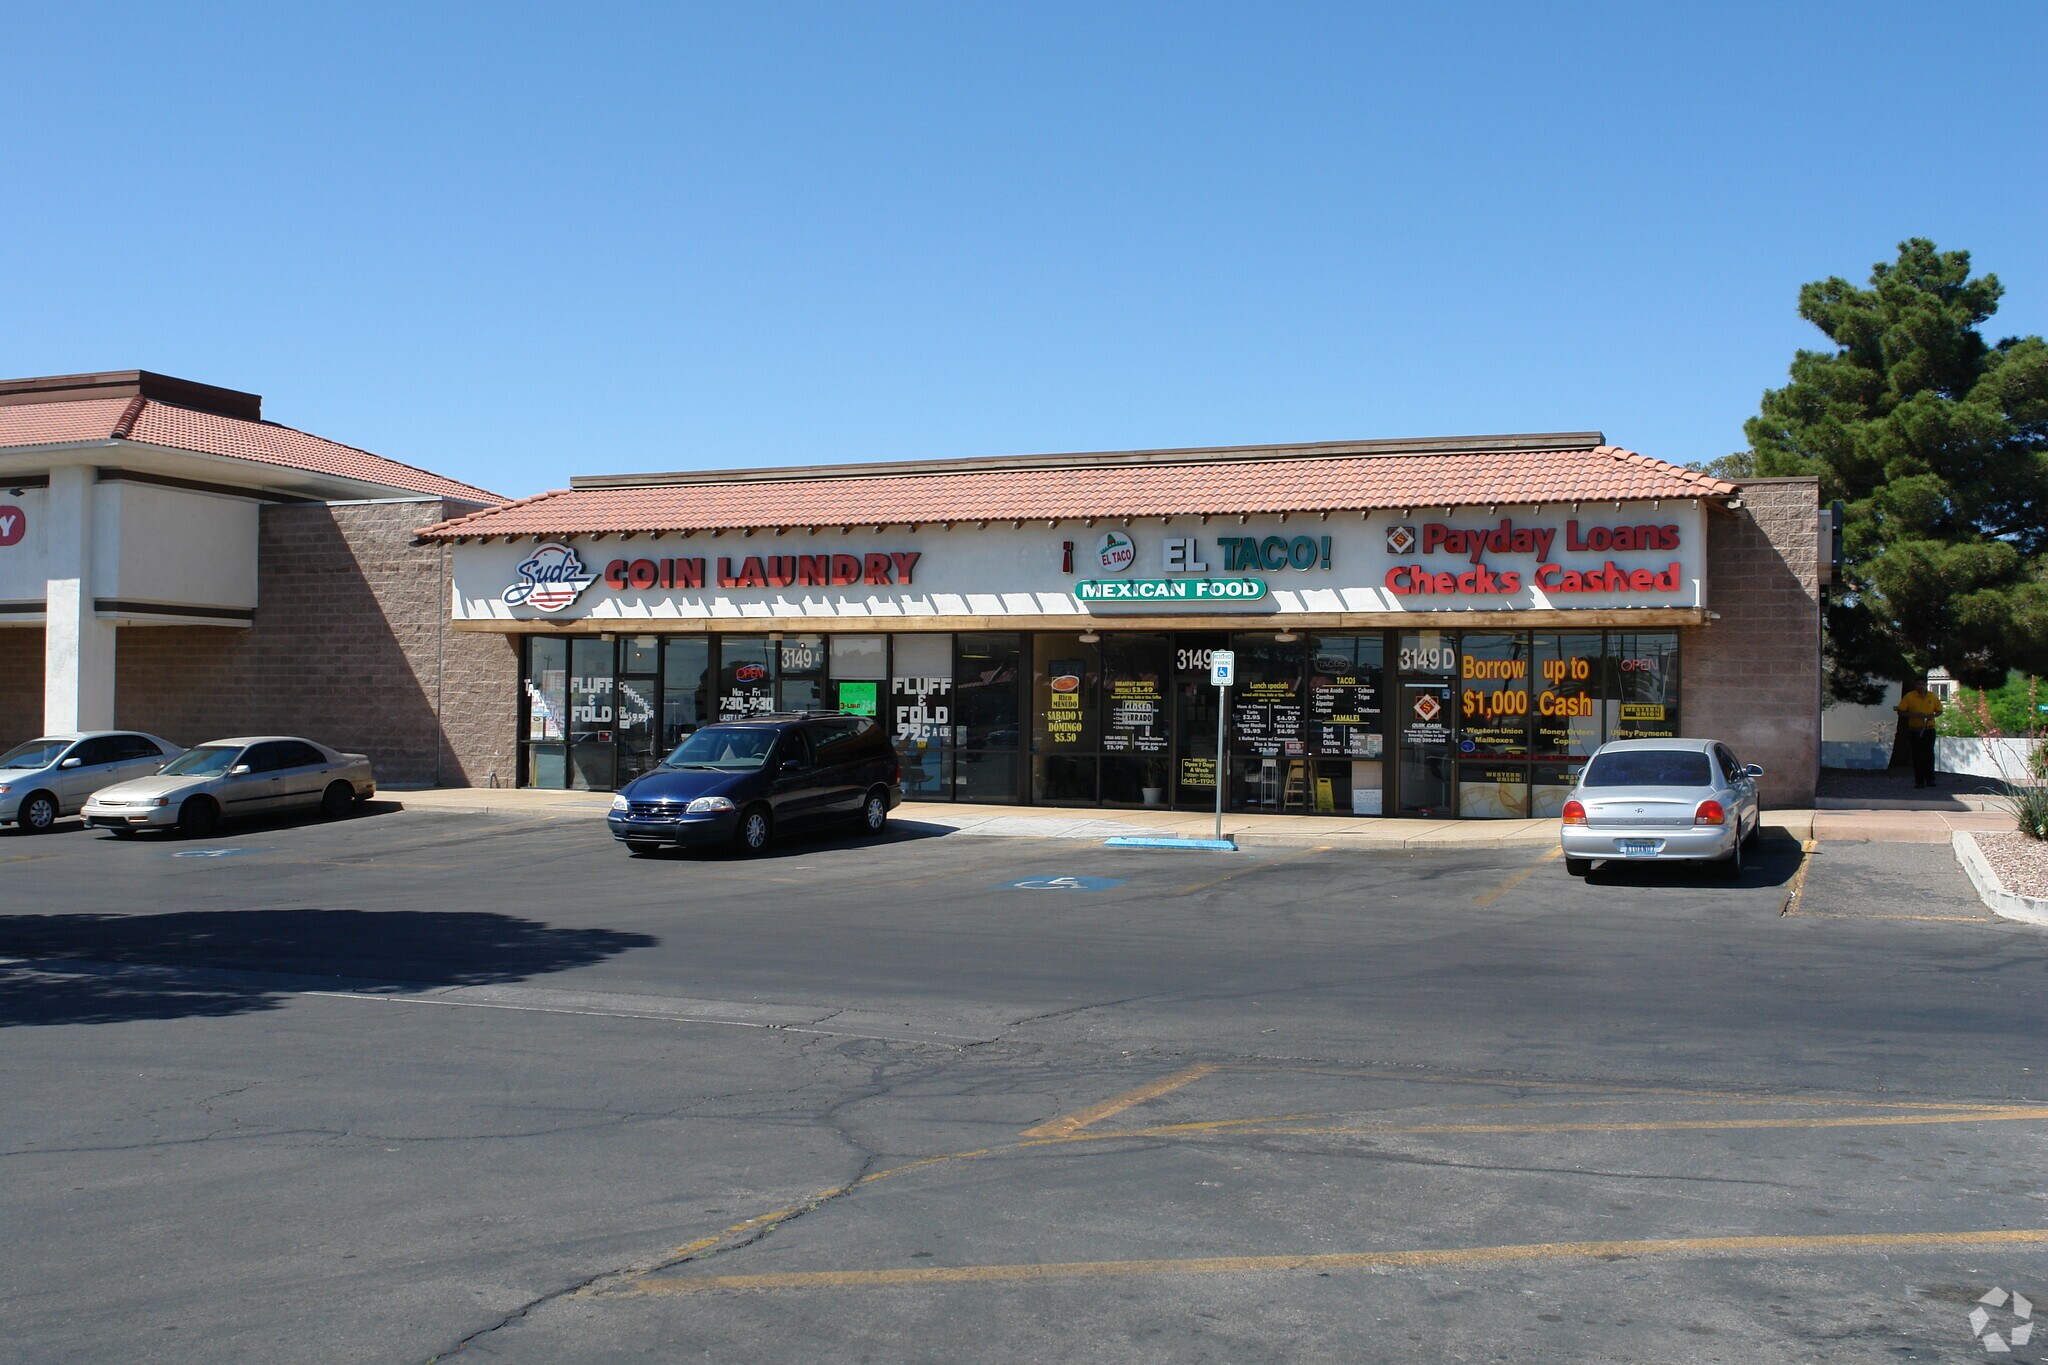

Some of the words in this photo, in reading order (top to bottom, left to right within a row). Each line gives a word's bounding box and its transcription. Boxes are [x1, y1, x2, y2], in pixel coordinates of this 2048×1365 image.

[1423, 519, 1556, 563] Payday
[1566, 520, 1681, 551] Loans
[1102, 554, 1111, 566] EL
[1112, 549, 1132, 563] TACO
[1163, 538, 1207, 572] EL
[1217, 535, 1332, 571] TACO!
[504, 552, 591, 603] Sudz
[604, 558, 706, 590] COIN
[716, 551, 922, 588] LAUNDRY
[1385, 564, 1521, 595] Checks
[1535, 561, 1681, 593] Cashed
[1082, 584, 1186, 598] MEXICAN
[1196, 582, 1259, 597] FOOD
[782, 649, 812, 668] 3149
[815, 654, 820, 662] A
[1177, 649, 1212, 670] 3149
[1319, 660, 1346, 668] TACOS
[1400, 648, 1440, 669] 3149
[1443, 648, 1455, 669] D
[1621, 659, 1660, 671] OPEN
[736, 668, 764, 679] OPEN
[1463, 655, 1526, 679] Borrow
[1543, 660, 1567, 684] up
[1570, 657, 1589, 679] to
[570, 677, 613, 694] FLUFF
[892, 678, 952, 695] FLUFF
[1268, 682, 1289, 690] specials
[1336, 677, 1356, 685] TACOS
[732, 688, 744, 697] Mon
[752, 688, 761, 697] Fri
[1125, 703, 1151, 711] CLOSED
[1463, 688, 1528, 718] $1,000
[1539, 690, 1593, 716] Cash
[571, 706, 613, 723] FOLD
[897, 707, 948, 724] FOLD
[1047, 711, 1076, 720] SABADO
[1078, 711, 1083, 720] Y
[1048, 722, 1082, 731] DOMINGO
[1540, 728, 1566, 736] Money
[1054, 733, 1077, 742] $5.50
